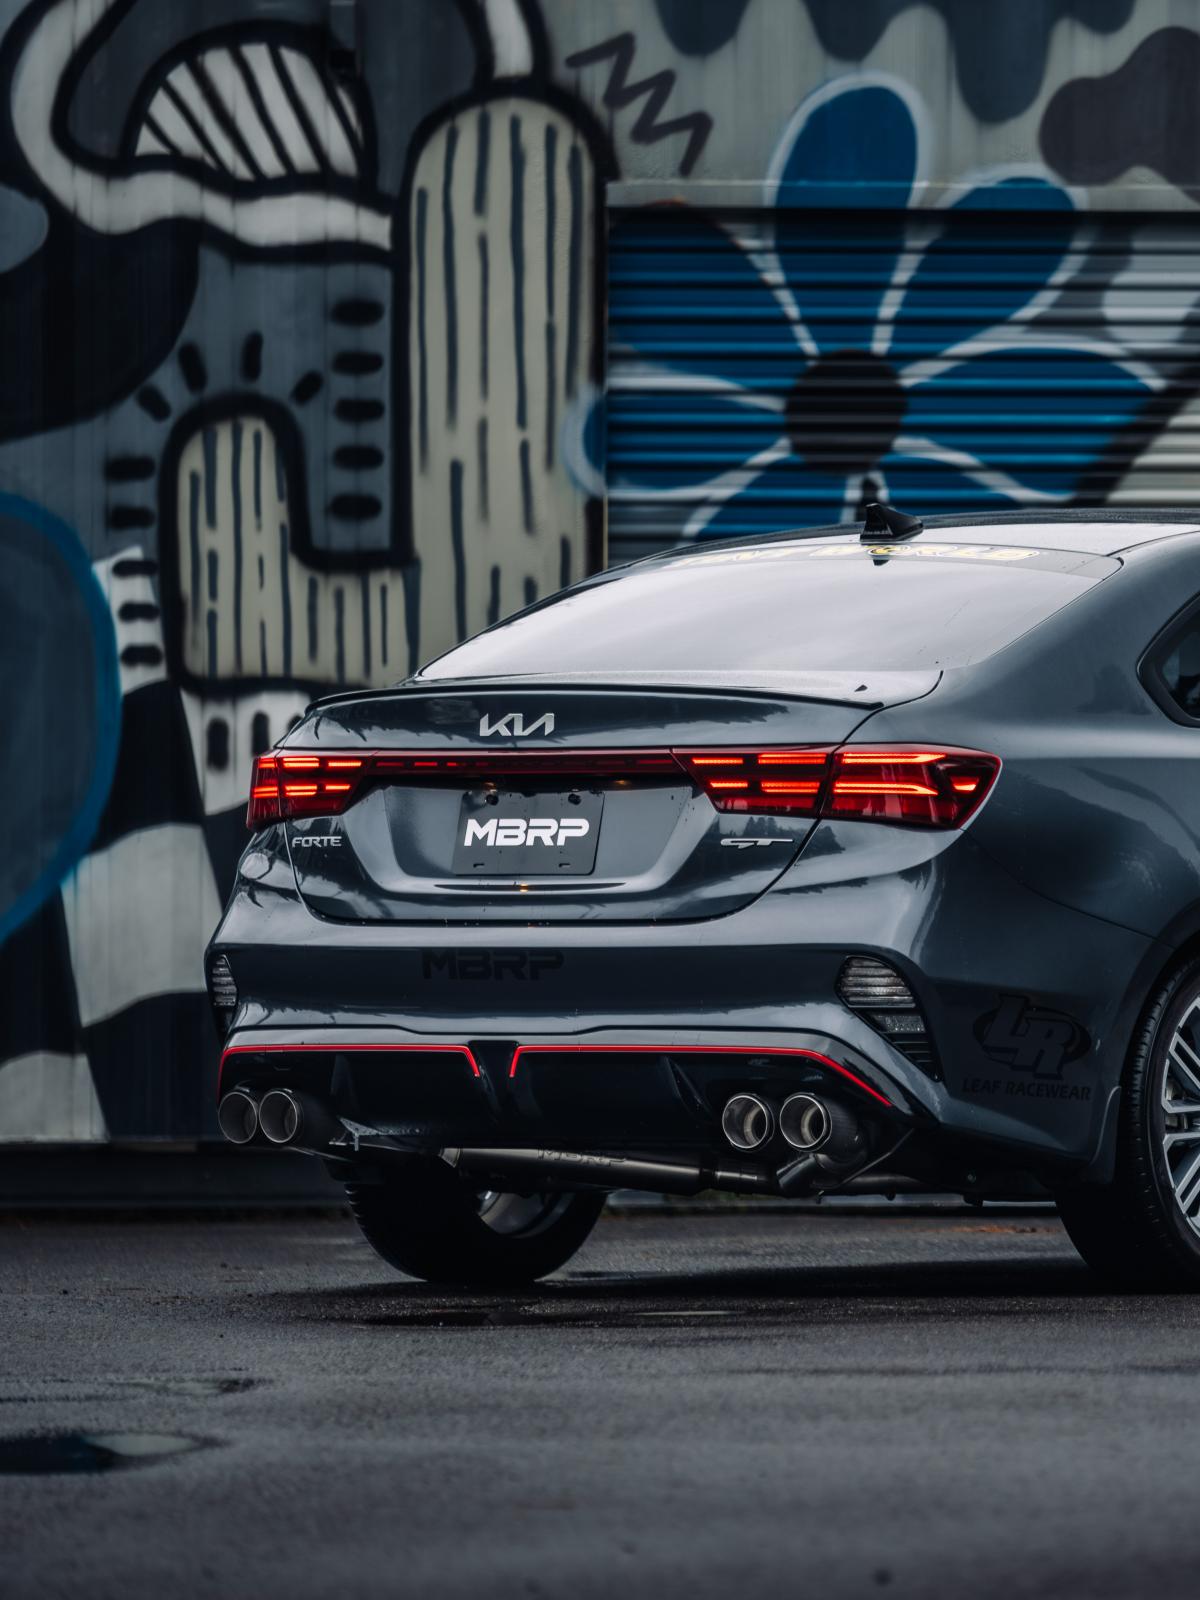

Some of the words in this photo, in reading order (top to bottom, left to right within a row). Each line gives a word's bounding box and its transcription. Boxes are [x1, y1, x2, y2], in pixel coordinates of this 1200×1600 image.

[479, 713, 555, 737] KIA
[292, 836, 342, 848] FORTE
[464, 818, 590, 847] MBRP
[422, 950, 565, 981] MBRP
[961, 1077, 1001, 1094] LEAF
[1005, 1080, 1092, 1100] RACEWEAR
